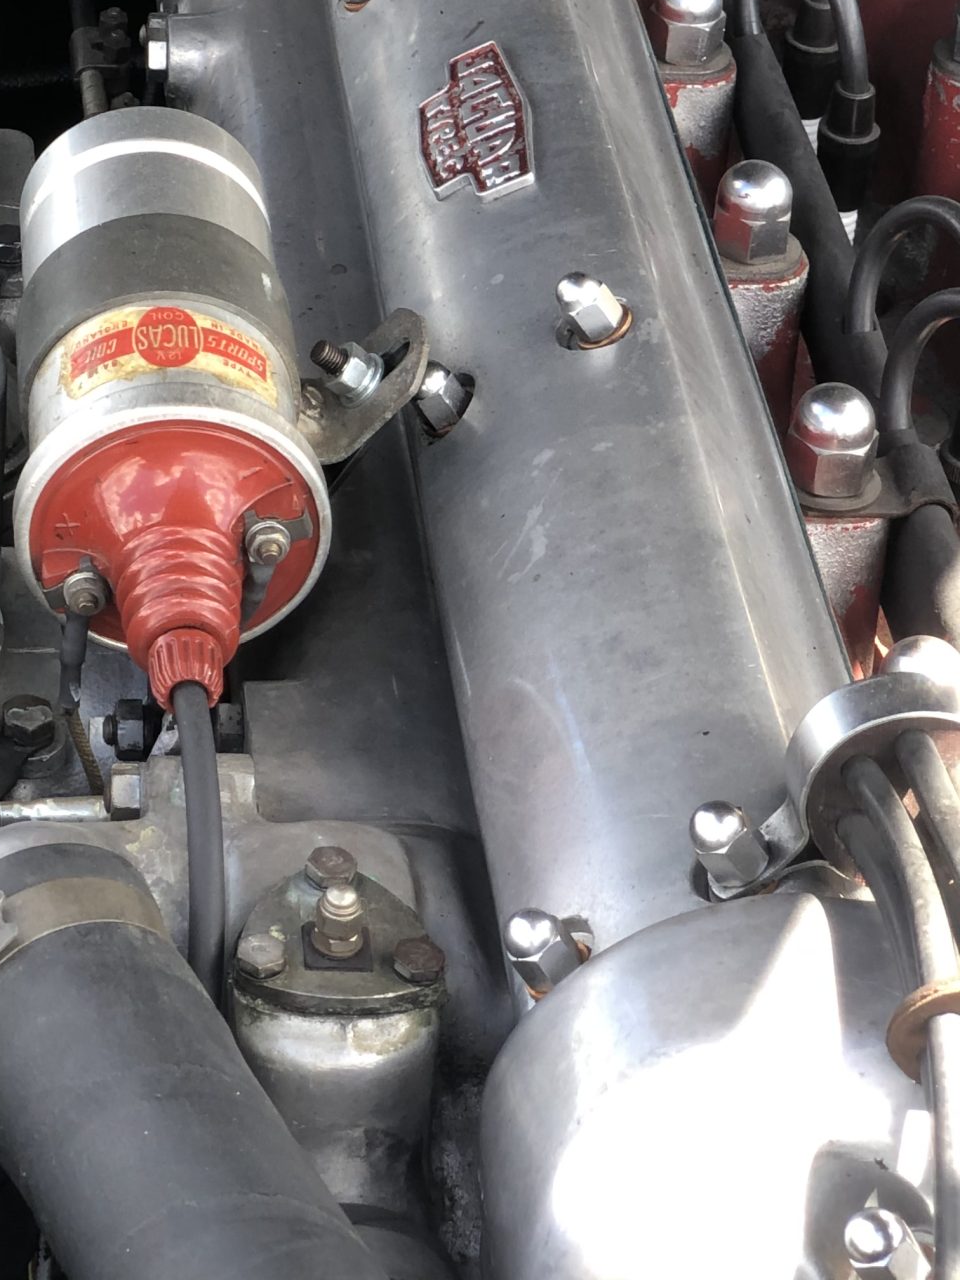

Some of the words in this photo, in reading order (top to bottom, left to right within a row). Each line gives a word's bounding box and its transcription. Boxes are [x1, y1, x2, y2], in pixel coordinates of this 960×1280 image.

[457, 50, 522, 187] JAGUAR
[150, 311, 184, 321] COIL
[136, 324, 199, 350] LUCAS
[84, 338, 118, 364] COIL
[207, 335, 265, 372] SPORTS
